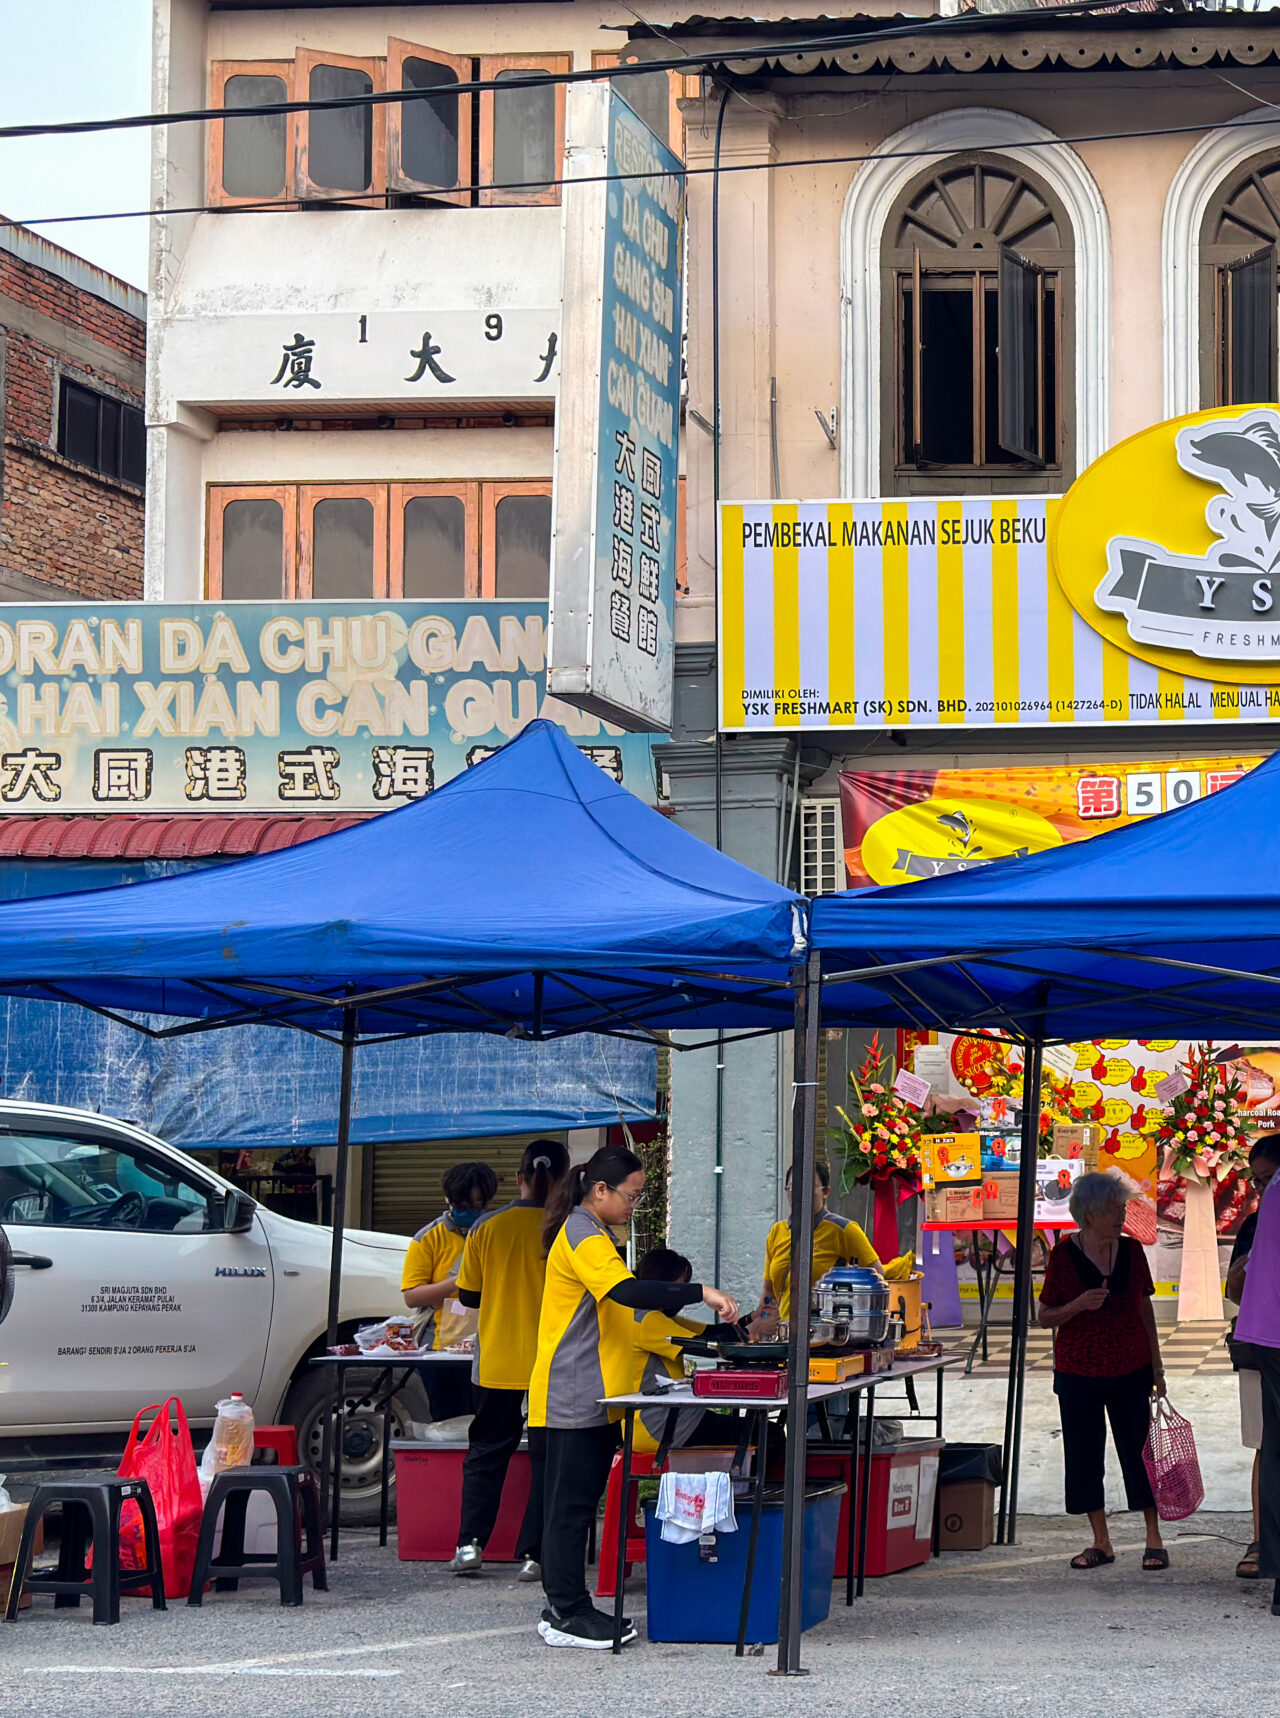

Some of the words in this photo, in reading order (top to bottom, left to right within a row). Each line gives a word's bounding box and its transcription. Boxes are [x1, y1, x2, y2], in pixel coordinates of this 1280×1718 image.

[613, 116, 680, 226] RESTORAN
[621, 188, 641, 246] DA
[642, 207, 669, 271] CHU
[612, 240, 650, 313] GANG
[651, 273, 673, 334] SHI
[613, 300, 638, 363] HAI
[638, 321, 670, 388] XIAN
[608, 357, 636, 426] CAN
[636, 380, 673, 450] GUAN
[742, 521, 837, 548] PEMBEKAL
[842, 519, 936, 547] MAKANAN
[941, 518, 995, 545] SEJUK
[1000, 517, 1046, 544] BEKU
[159, 617, 250, 674] DA
[259, 615, 392, 673] CHU
[741, 688, 784, 699] DIMILIKI
[788, 688, 820, 699] OLEH:
[1129, 693, 1161, 709] TIDAK
[1164, 692, 1201, 709] HALAL
[1210, 690, 1263, 708] MENJUAL
[17, 682, 120, 737] HAI
[132, 680, 280, 737] XIAN
[296, 680, 429, 737] CAN
[742, 703, 769, 716] YSK
[774, 701, 859, 715] FRESHMART
[863, 700, 893, 717] (SK)
[897, 700, 932, 713] SDN.
[937, 699, 971, 712] BHD.
[975, 701, 1053, 712] 202101026964
[1055, 698, 1123, 712] (1427264-D)
[1235, 1108, 1266, 1117] harcoal
[1257, 1120, 1275, 1128] Pork
[215, 1266, 267, 1278] HILUX
[100, 1286, 111, 1295] SRI
[111, 1286, 140, 1295] MAGJUTA
[140, 1286, 153, 1295] SDN
[154, 1286, 167, 1295] BHD
[107, 1295, 127, 1304] JALAN
[128, 1295, 156, 1304] KERAMAT
[157, 1295, 175, 1303] PULAI
[81, 1304, 98, 1313] 31300
[99, 1304, 129, 1312] KAMPUNG
[130, 1304, 160, 1312] KEPAYANG
[161, 1304, 182, 1312] PERAK
[88, 1346, 112, 1355] SENDIRI
[132, 1346, 155, 1354] ORANG
[155, 1344, 182, 1353] PEKERJA
